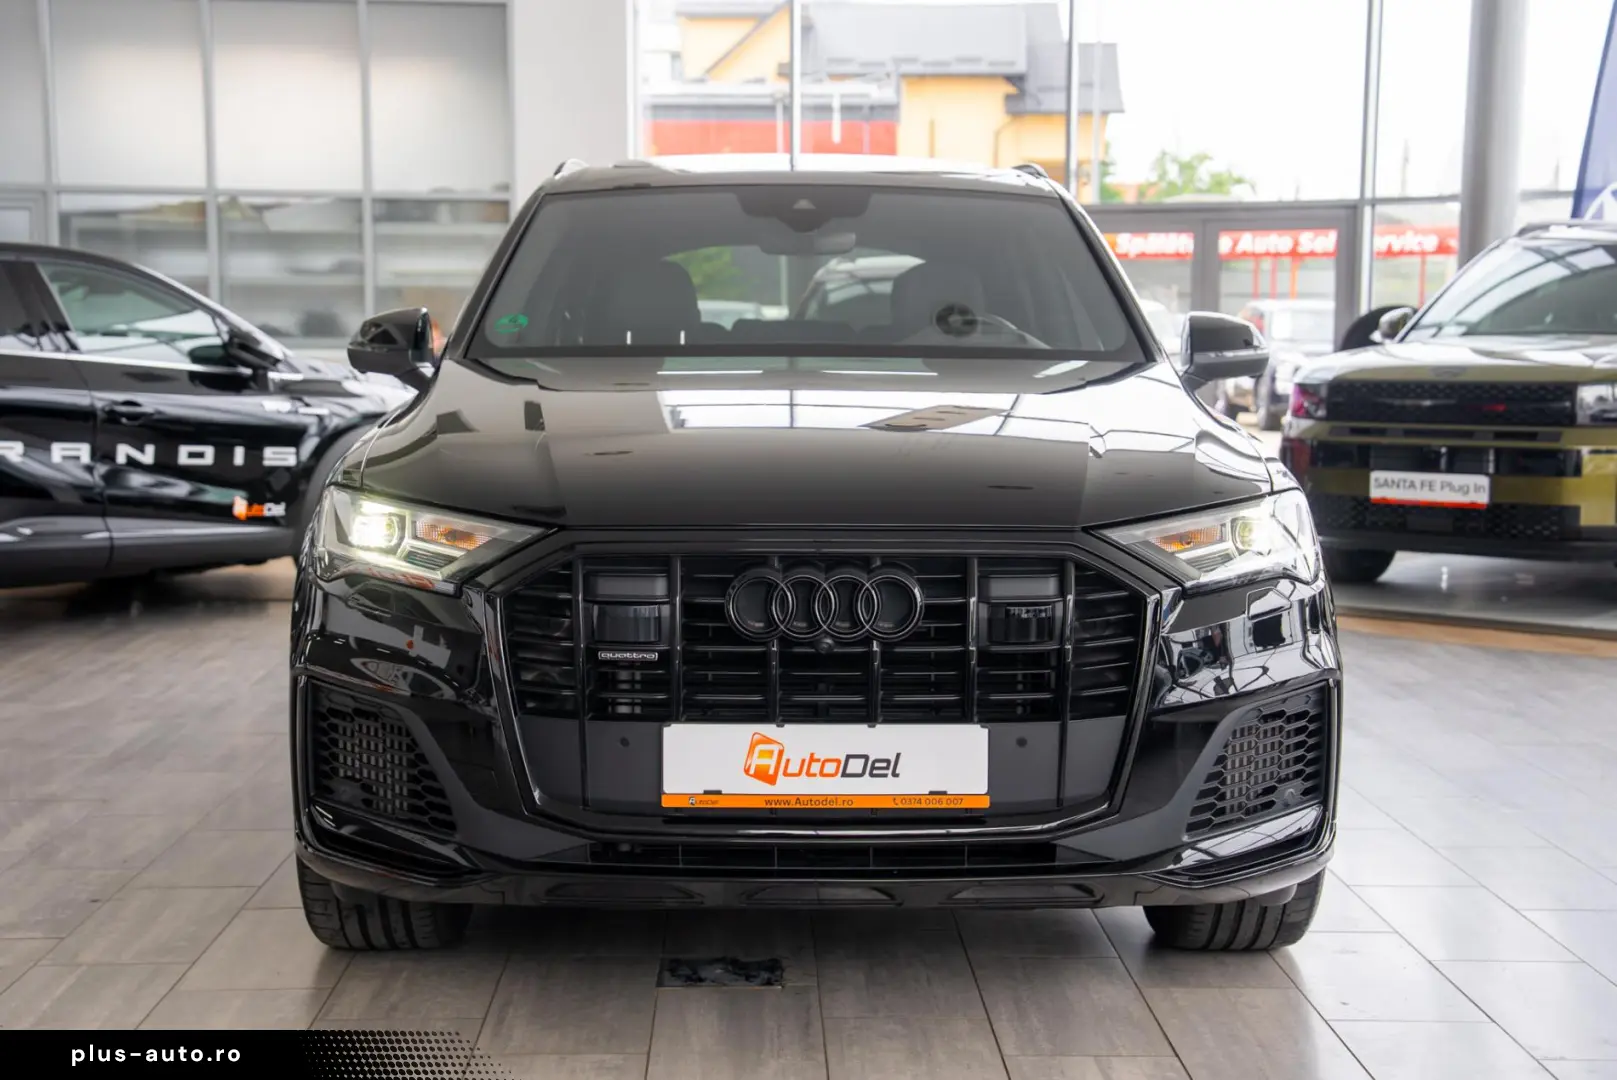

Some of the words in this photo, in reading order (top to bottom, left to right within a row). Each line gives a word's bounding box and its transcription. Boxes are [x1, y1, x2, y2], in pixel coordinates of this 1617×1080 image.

[1235, 232, 1293, 254] Auto
[1297, 231, 1338, 253] Sel
[0, 440, 298, 467] RANDIS
[1374, 477, 1417, 491] SANTA
[1420, 479, 1437, 492] FE
[1440, 480, 1470, 496] Plug
[1474, 482, 1486, 494] In
[601, 652, 656, 660] quattro
[748, 742, 902, 779] AutoDel
[764, 796, 854, 807] www.Autodel.ro
[901, 797, 922, 806] 0374
[924, 797, 944, 806] 006
[945, 797, 965, 806] 007
